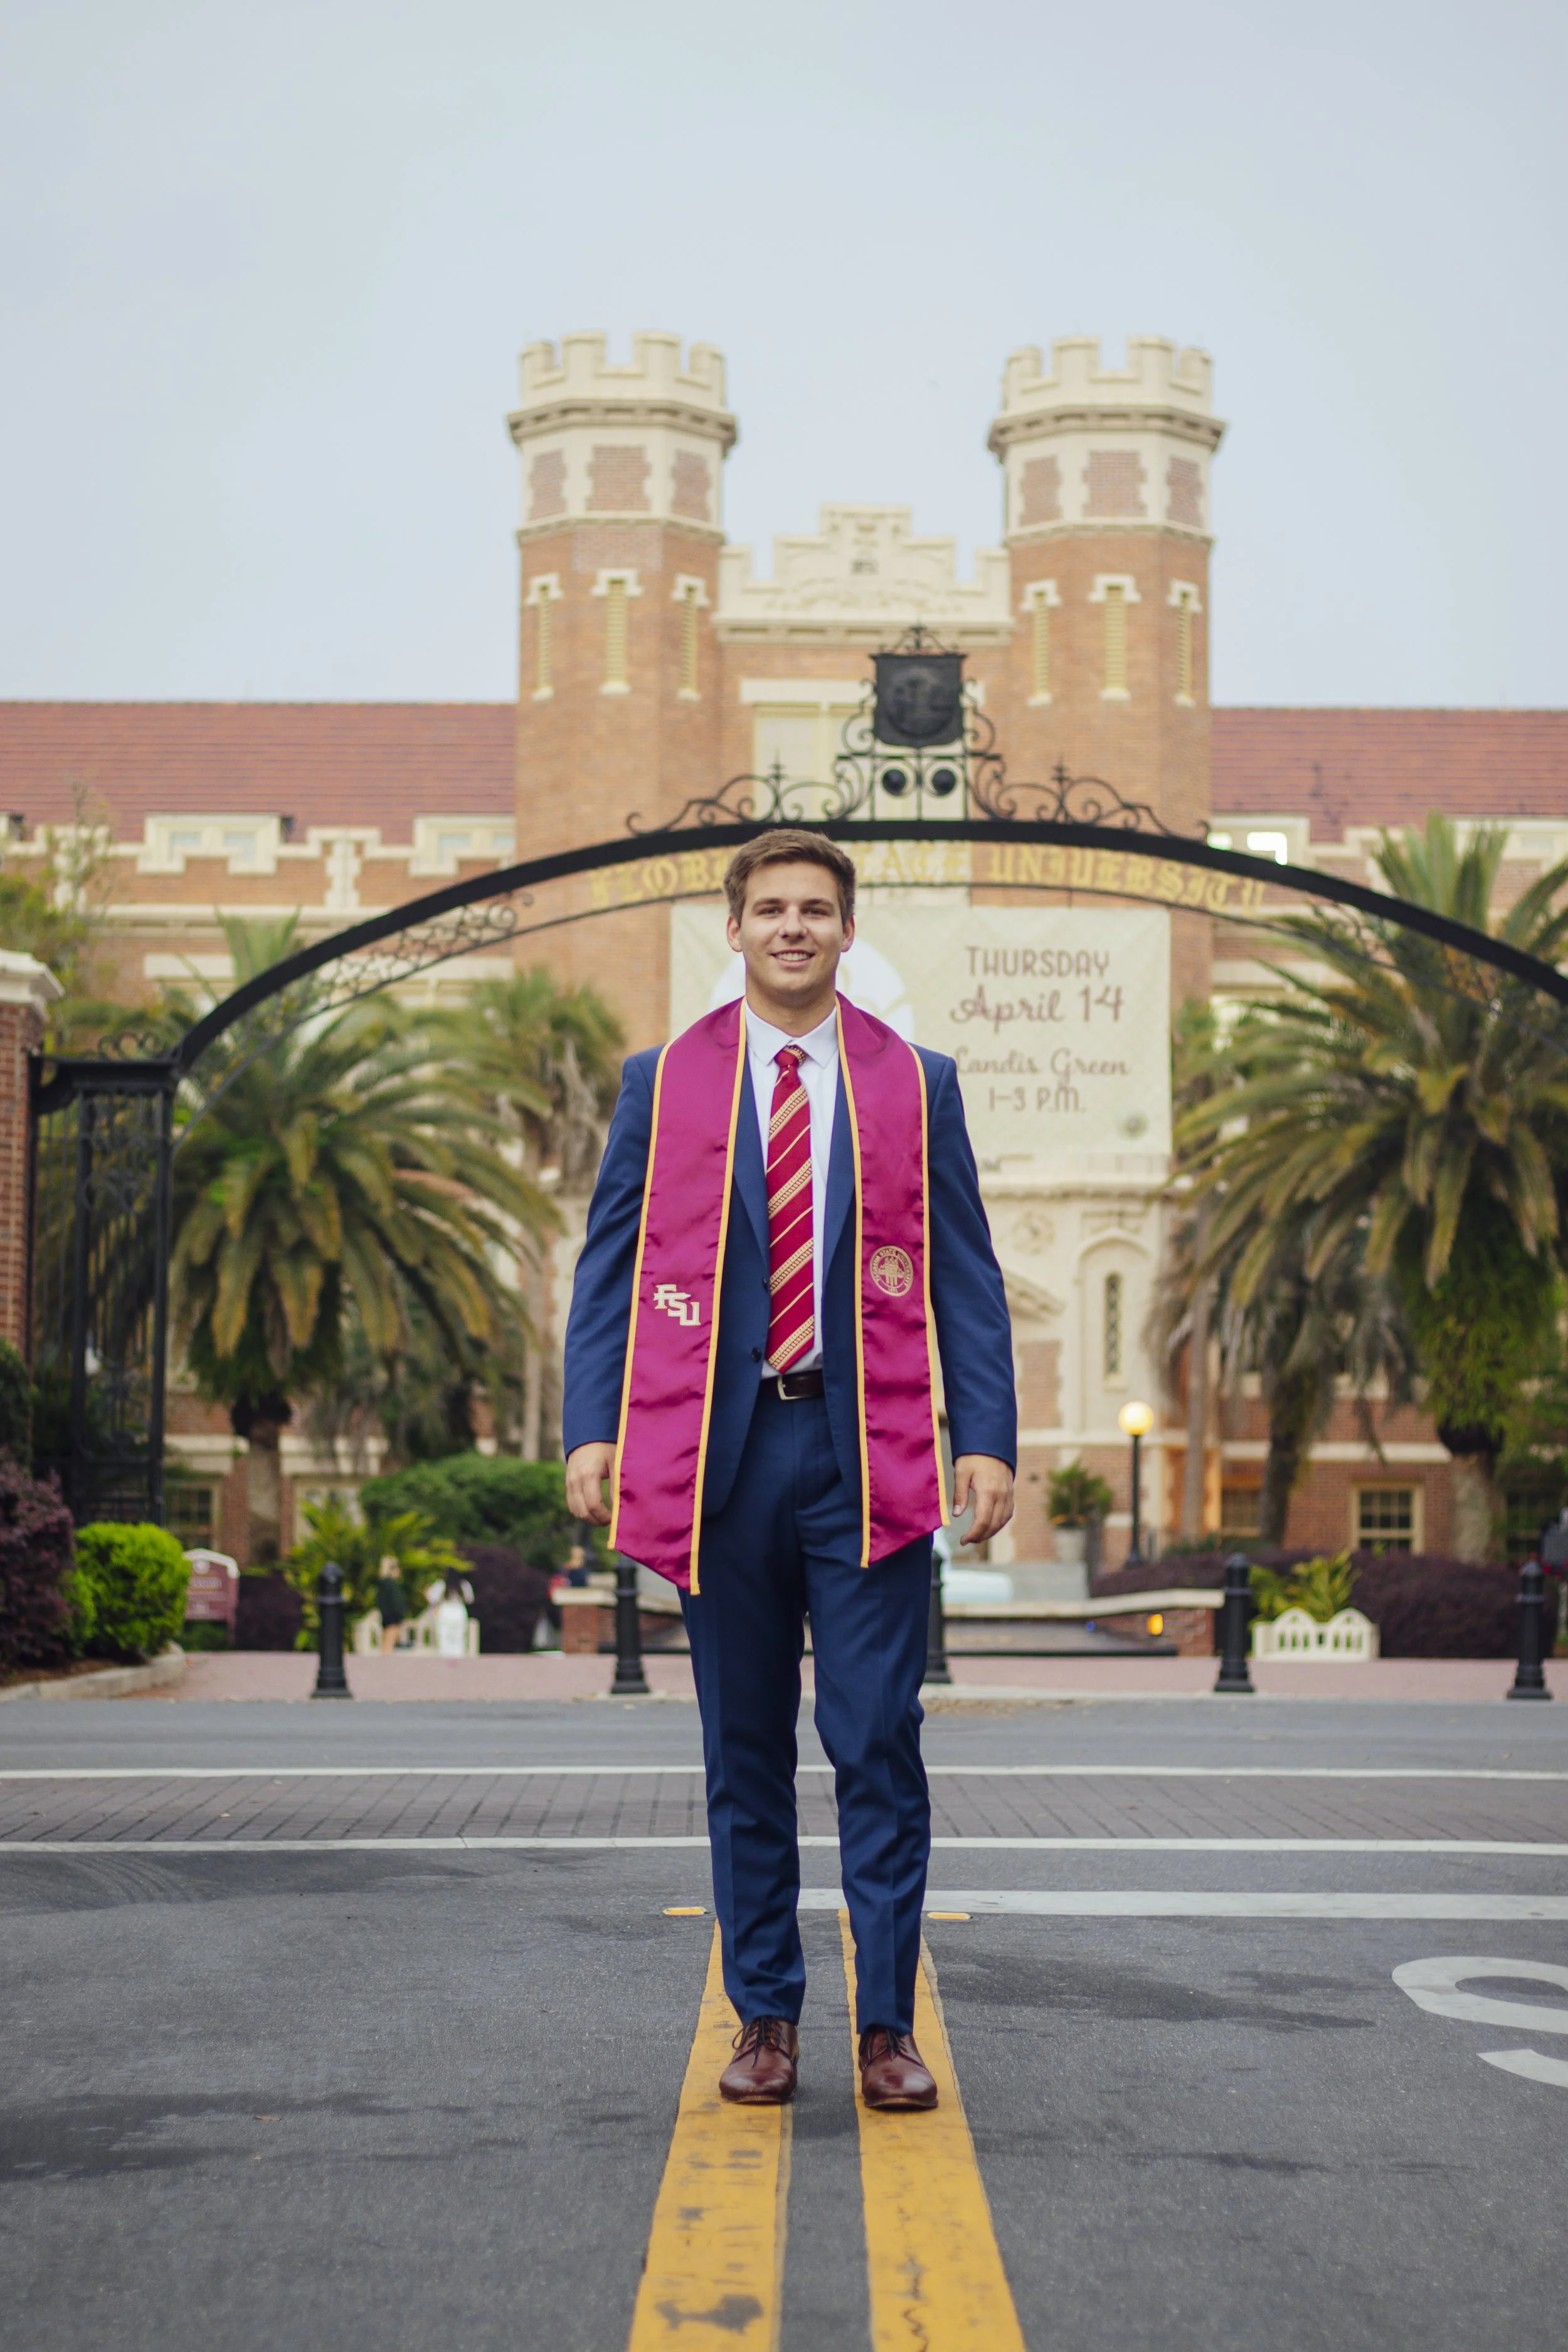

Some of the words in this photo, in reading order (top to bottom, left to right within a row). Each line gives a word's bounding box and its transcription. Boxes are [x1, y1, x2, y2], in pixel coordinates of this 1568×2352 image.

[965, 946, 1110, 978] THURSDAY
[949, 983, 1064, 1034] April
[1078, 984, 1124, 1022] 14
[1050, 1047, 1130, 1087] Green
[654, 1284, 701, 1326] FSU
